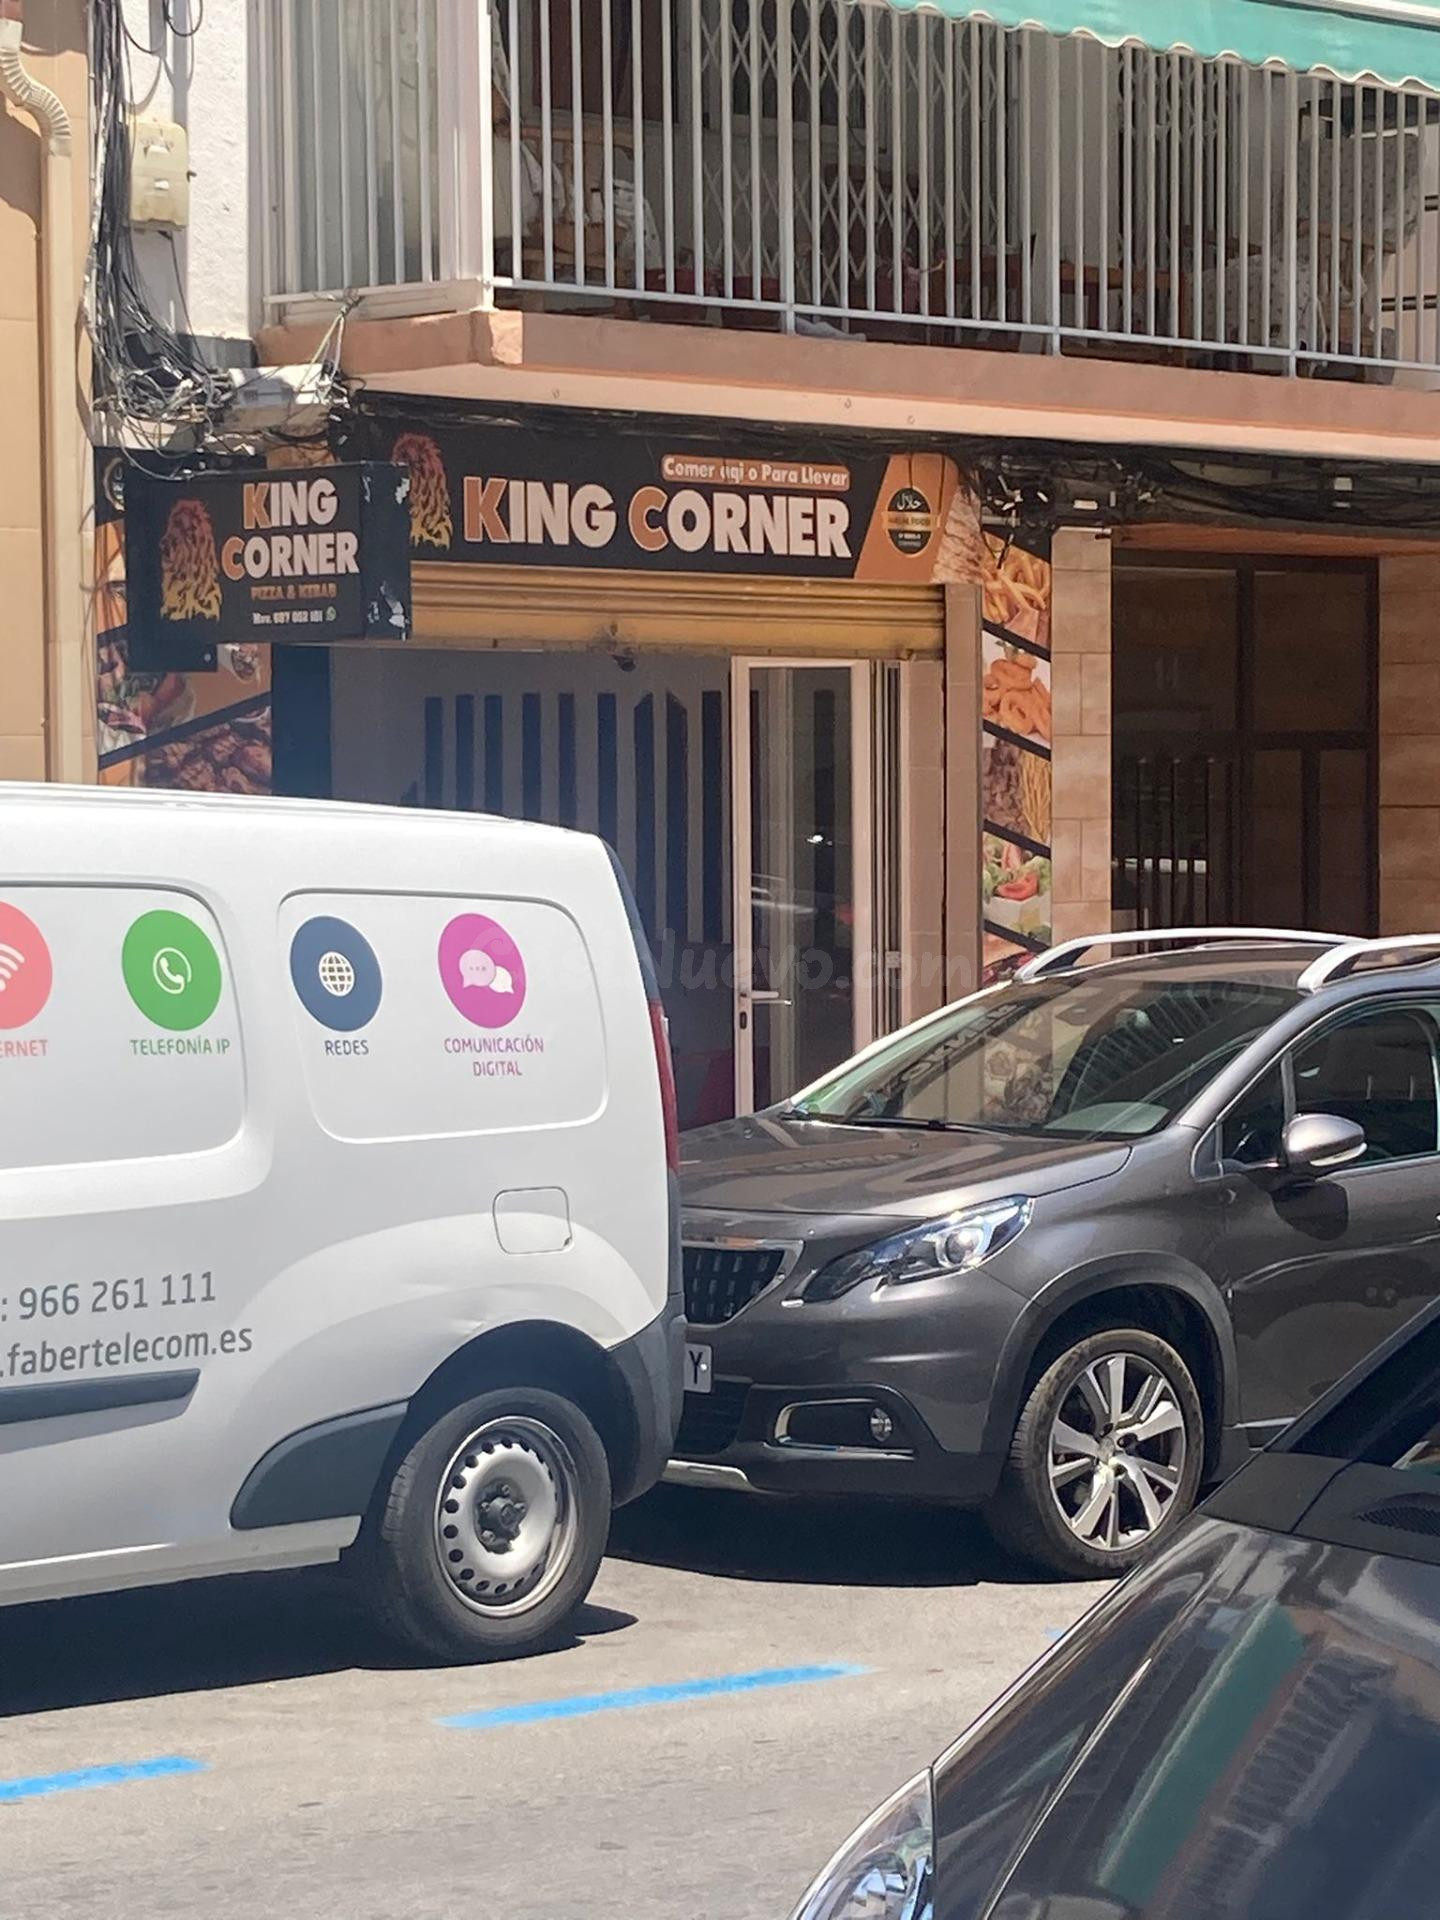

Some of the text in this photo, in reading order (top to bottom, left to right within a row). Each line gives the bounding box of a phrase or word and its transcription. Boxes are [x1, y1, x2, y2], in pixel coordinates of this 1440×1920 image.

[664, 457, 715, 478] Comer
[748, 467, 758, 481] o
[761, 463, 798, 483] Para
[801, 466, 848, 486] Llevar
[243, 478, 338, 530] KING
[463, 476, 852, 558] KING CORNER
[221, 531, 360, 581] CORNER
[130, 1035, 230, 1056] TELEFONÍA IP
[324, 1039, 369, 1056] REDES
[444, 1034, 544, 1054] COMUNICACIÓN
[472, 1060, 522, 1077] DIGITAL
[19, 1283, 79, 1320] 966
[91, 1277, 148, 1312] 261
[161, 1271, 216, 1306] 111
